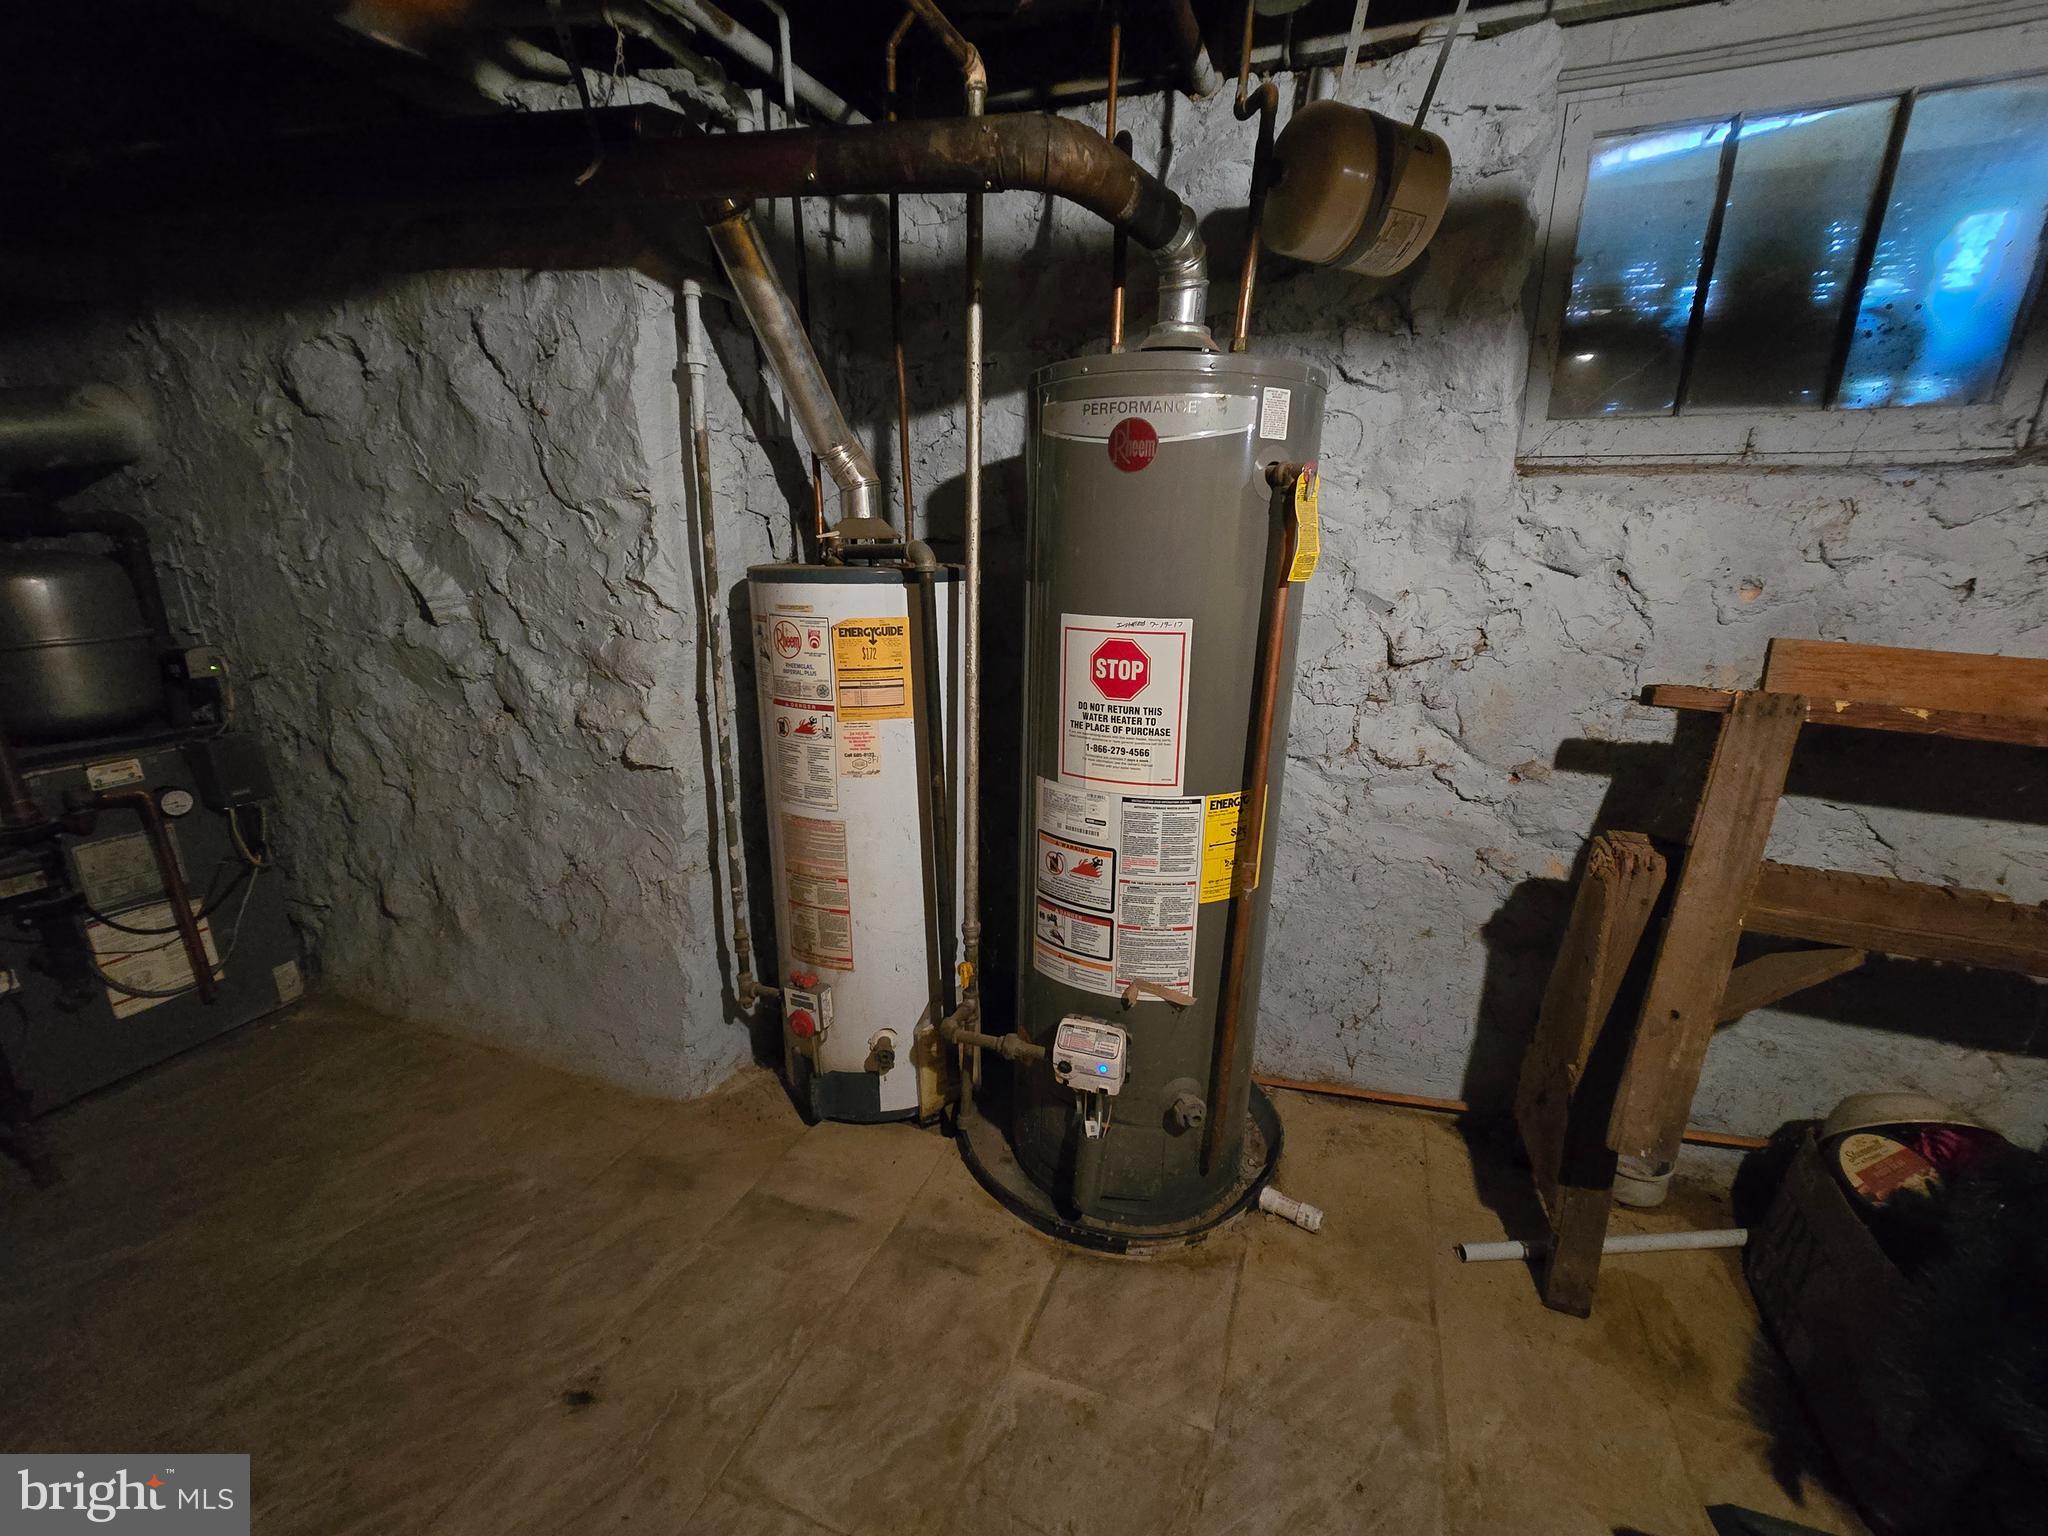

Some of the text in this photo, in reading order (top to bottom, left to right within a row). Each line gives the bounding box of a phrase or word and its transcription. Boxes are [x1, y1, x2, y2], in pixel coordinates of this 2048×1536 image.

[1083, 400, 1197, 416] PERFORMANCE
[1113, 419, 1156, 465] Rheem
[776, 624, 801, 653] Rheem
[838, 626, 904, 638] ENERGYGUIDE
[1095, 658, 1145, 681] STOP
[1078, 701, 1163, 717] DO NOT RETURN THIS
[1082, 712, 1157, 727] WATER HEATER TO
[1070, 719, 1171, 737] THE PLACE OF PURCHASE
[1086, 743, 1150, 758] 1-866-279-4566
[1061, 843, 1090, 854] WARNING
